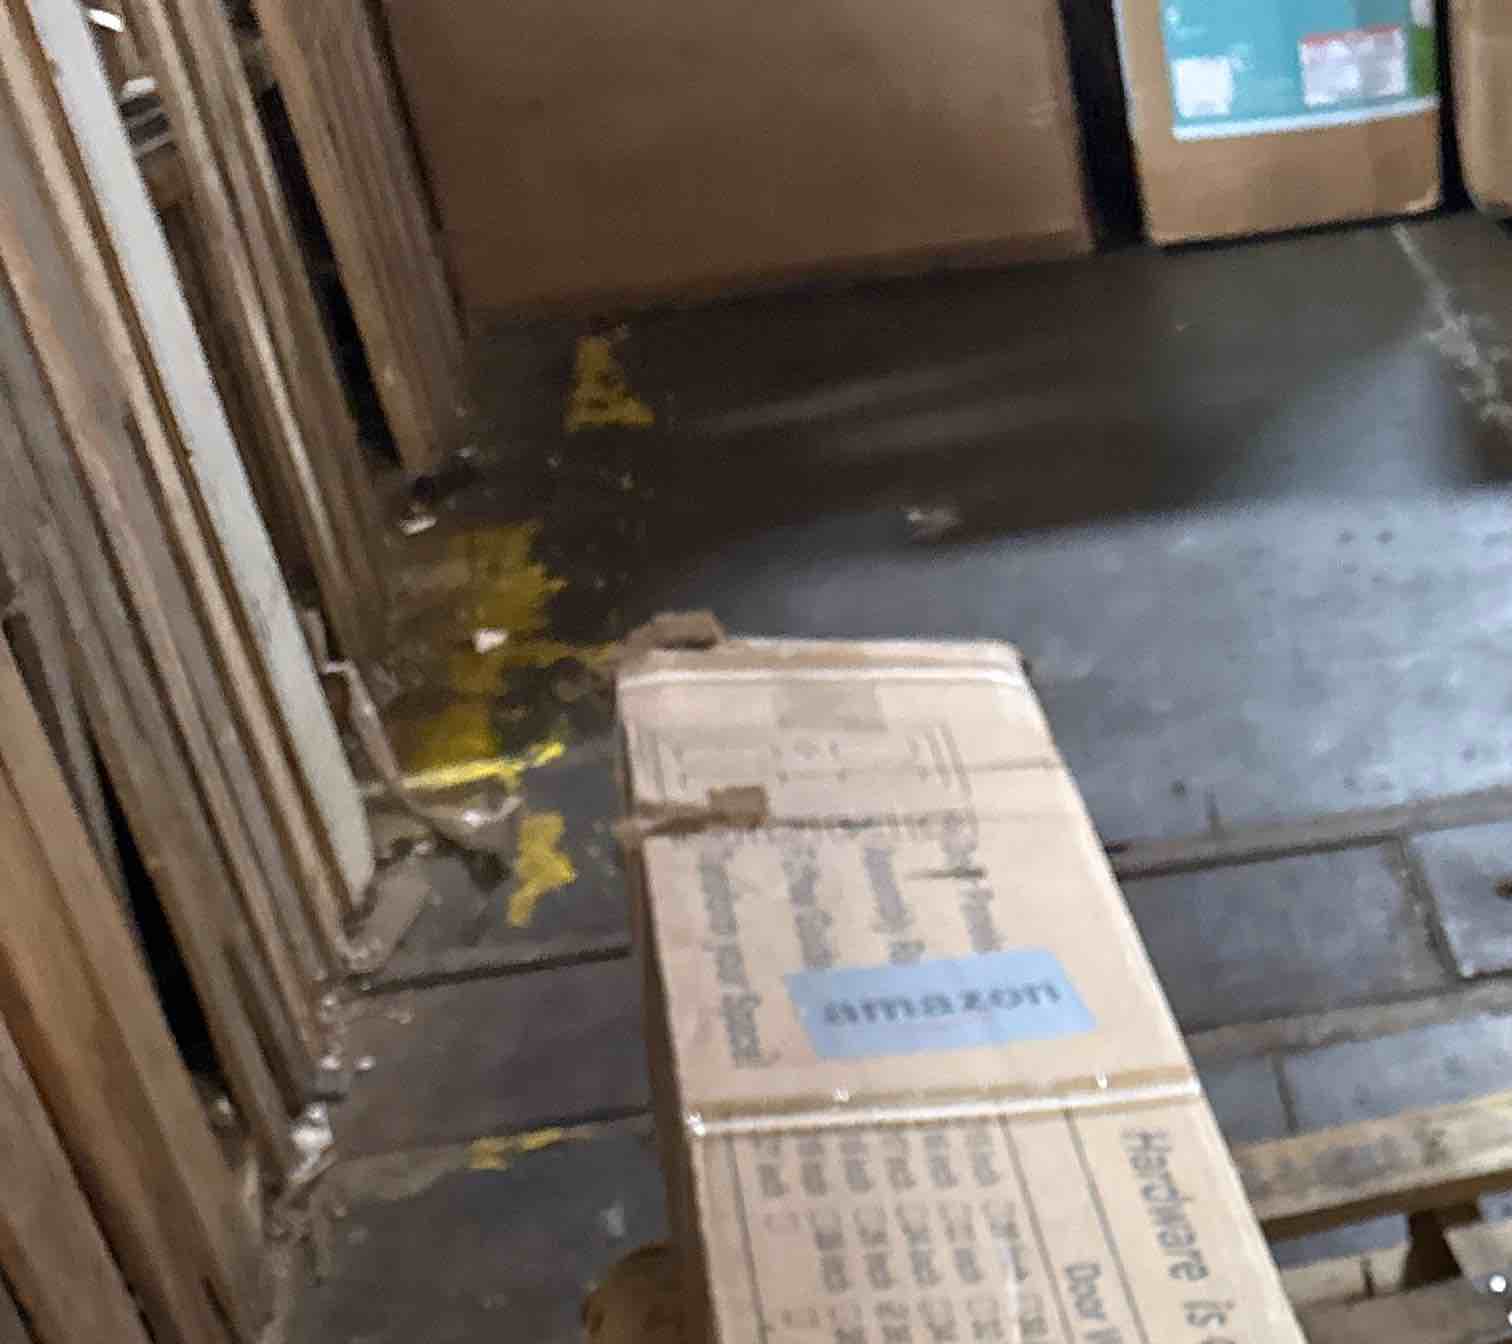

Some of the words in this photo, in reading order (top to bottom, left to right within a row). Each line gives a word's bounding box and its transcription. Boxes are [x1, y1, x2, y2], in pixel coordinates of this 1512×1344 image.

[823, 979, 1062, 1027] amazon
[1120, 1131, 1209, 1282] Hardware
[1183, 1301, 1235, 1329] is
